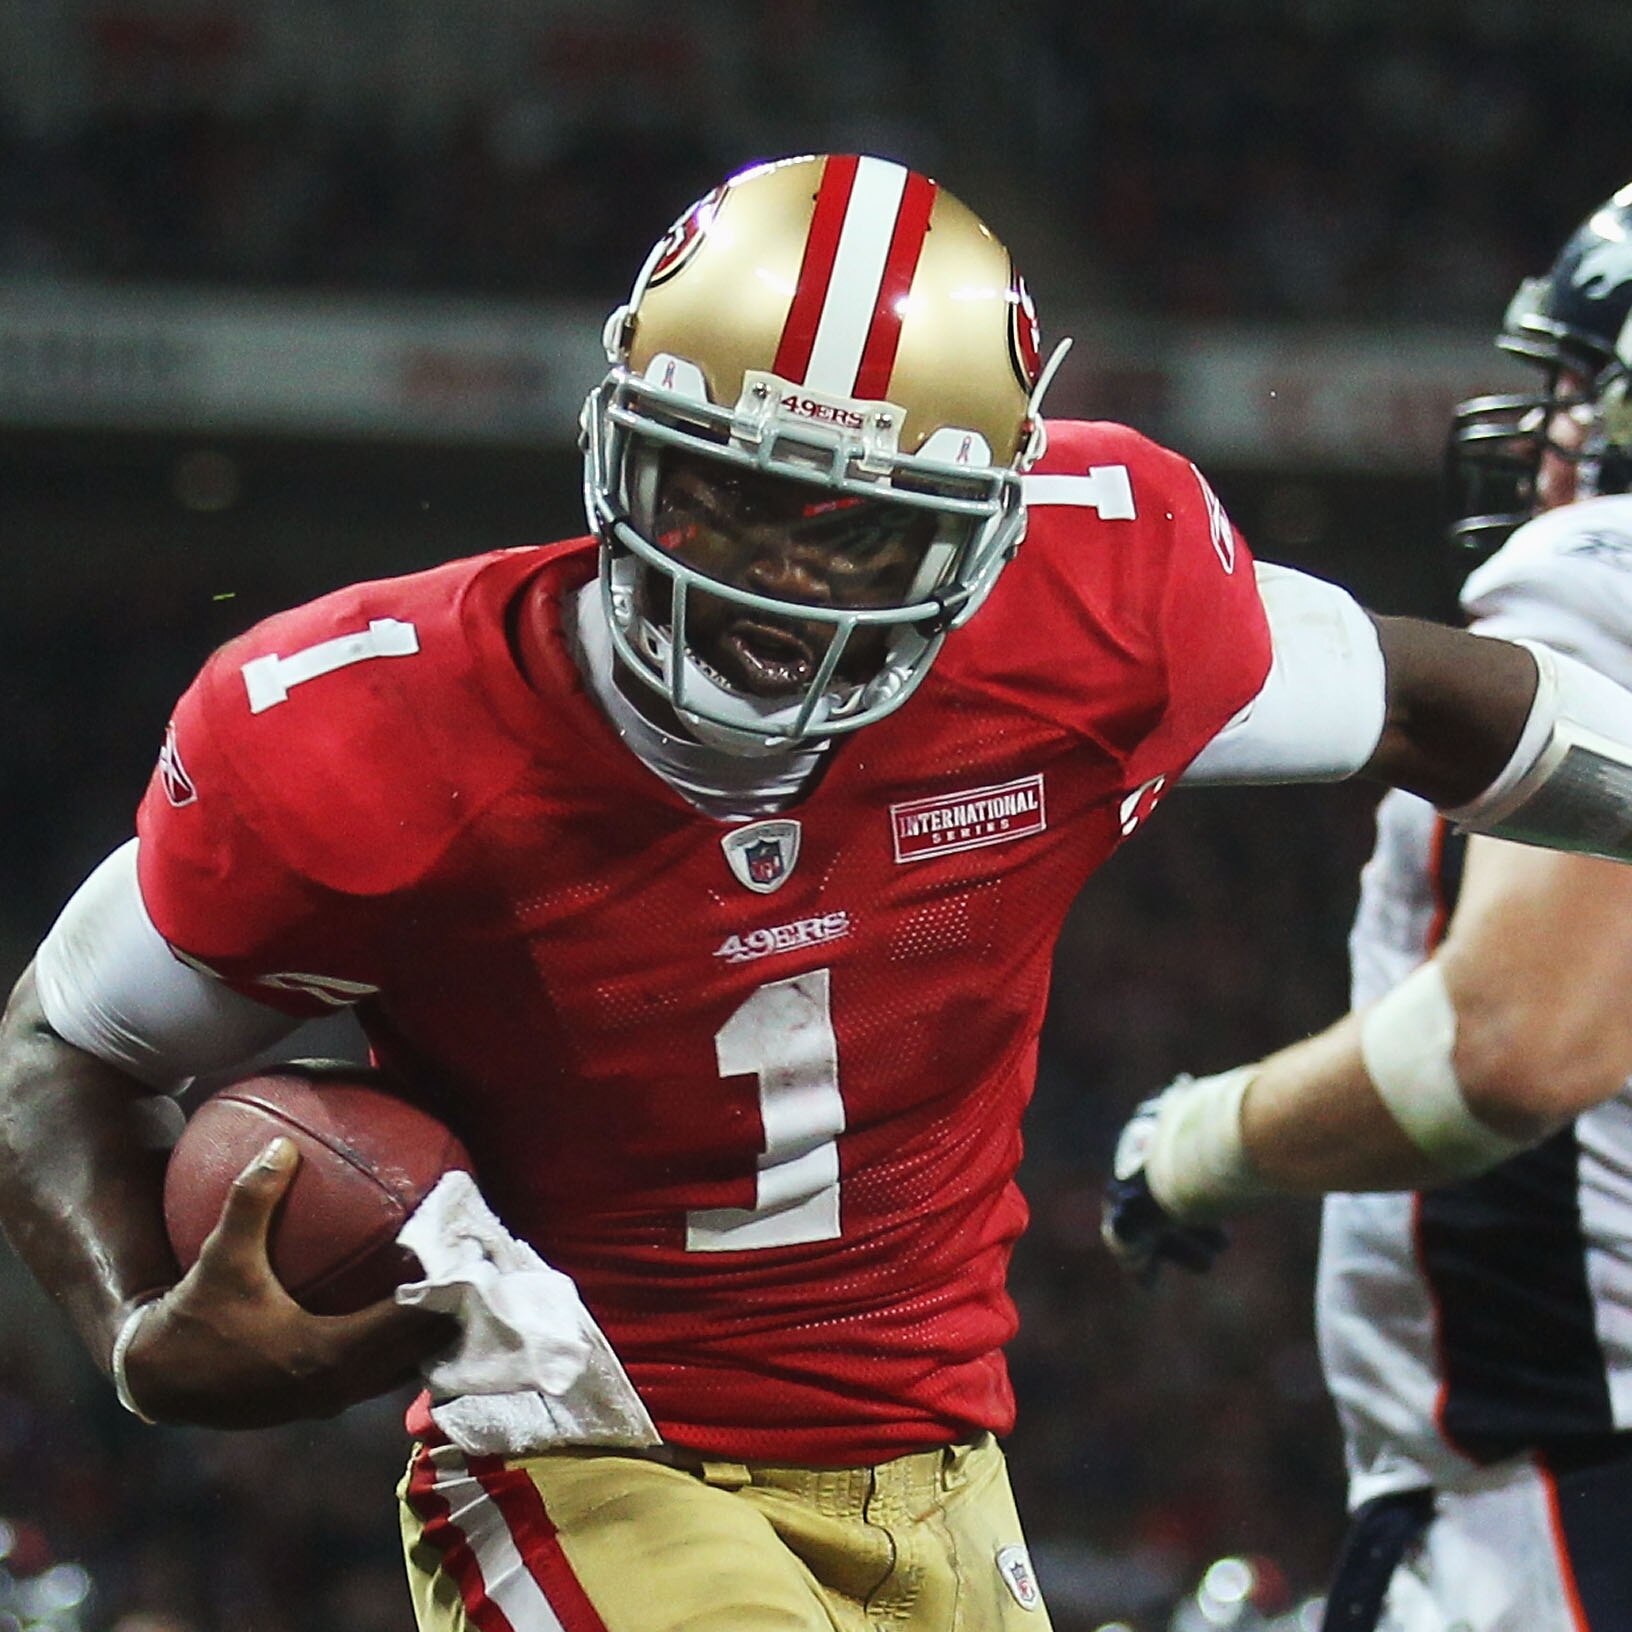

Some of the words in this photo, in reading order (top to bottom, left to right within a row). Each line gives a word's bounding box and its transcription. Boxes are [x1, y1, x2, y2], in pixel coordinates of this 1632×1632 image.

[781, 395, 864, 429] 49ERS
[241, 617, 420, 715] 1
[899, 789, 1038, 838] INTERNATIONAL
[932, 818, 1010, 844] SERIES
[712, 911, 850, 964] 49ERS
[685, 967, 848, 1252] 1
